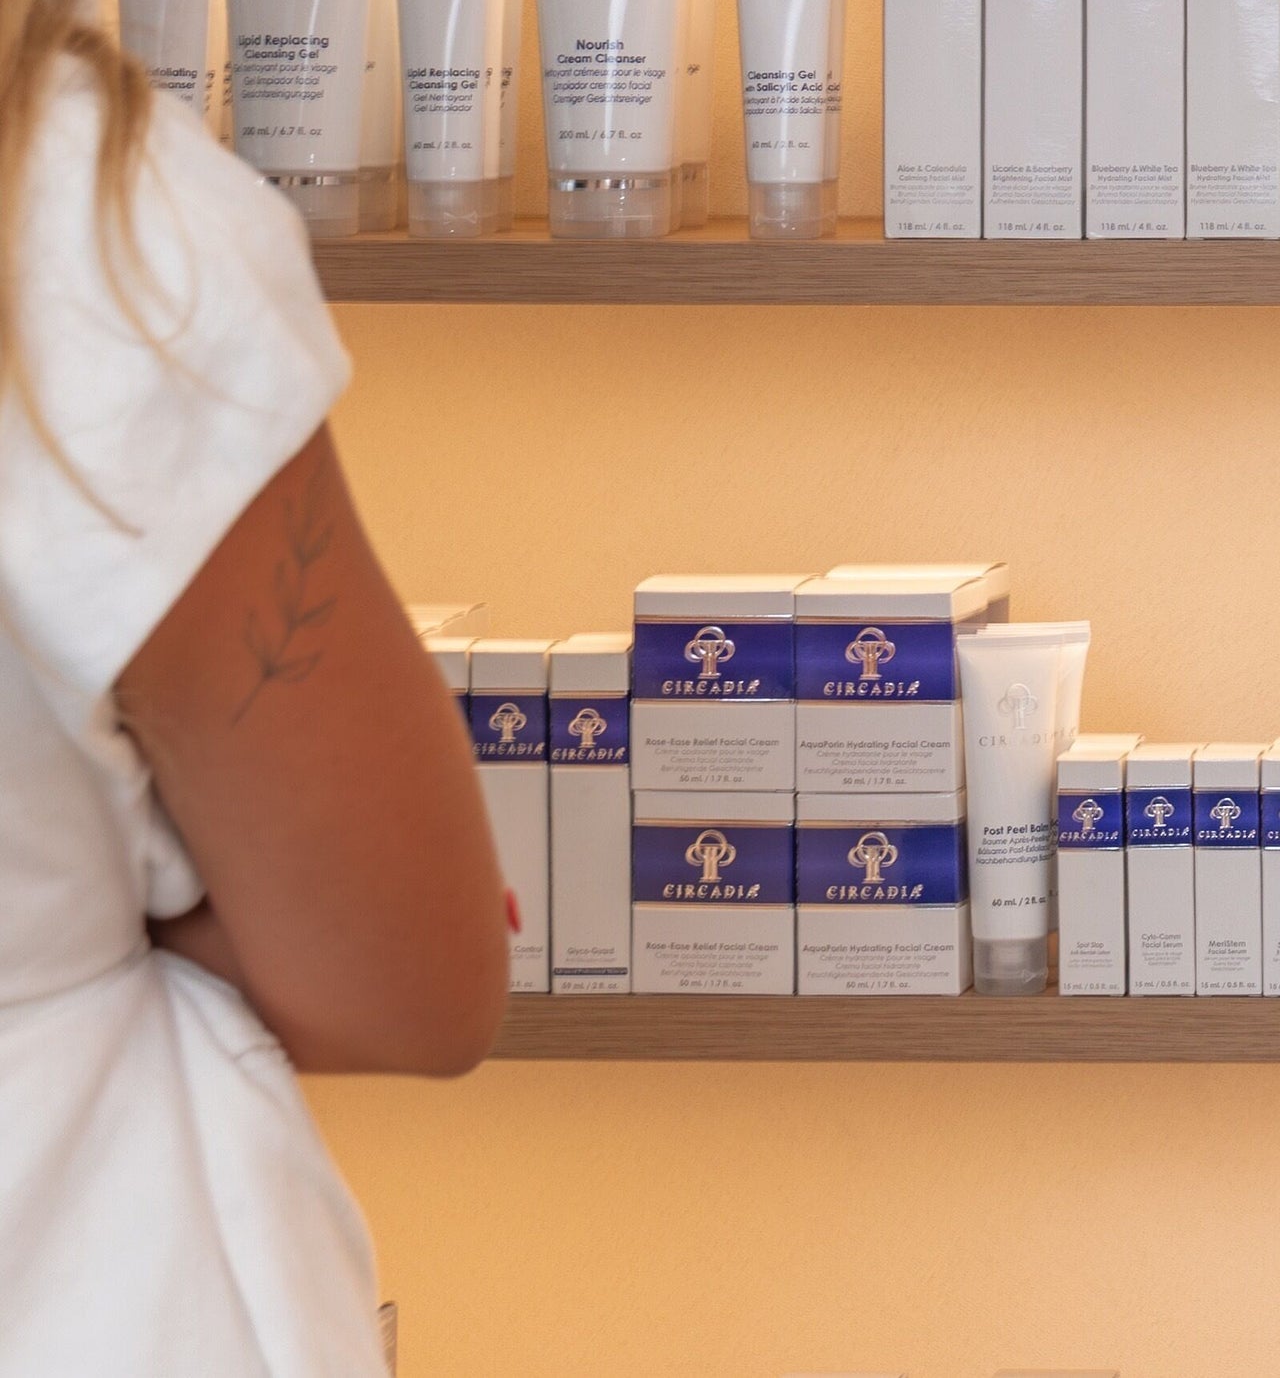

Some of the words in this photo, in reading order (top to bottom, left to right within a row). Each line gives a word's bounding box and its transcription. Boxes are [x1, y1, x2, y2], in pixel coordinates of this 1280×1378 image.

[265, 35, 329, 48] Replacing
[576, 39, 624, 50] Nourish
[244, 48, 295, 60] Cleansing
[299, 48, 320, 60] Gel
[557, 54, 592, 64] Cream
[595, 53, 646, 64] Cleanser
[747, 69, 794, 82] Cleansing
[798, 69, 816, 81] Gel
[757, 82, 798, 92] Salicylic
[801, 82, 824, 92] Acid
[695, 738, 717, 746] Relief
[720, 738, 745, 746] Facial
[748, 738, 778, 746] Cream
[800, 740, 844, 750] AquaPorin
[847, 740, 888, 750] Hydrating
[892, 740, 917, 748] Facial
[921, 740, 950, 748] Cream
[984, 826, 1004, 835] Post
[1007, 826, 1027, 835] Peel
